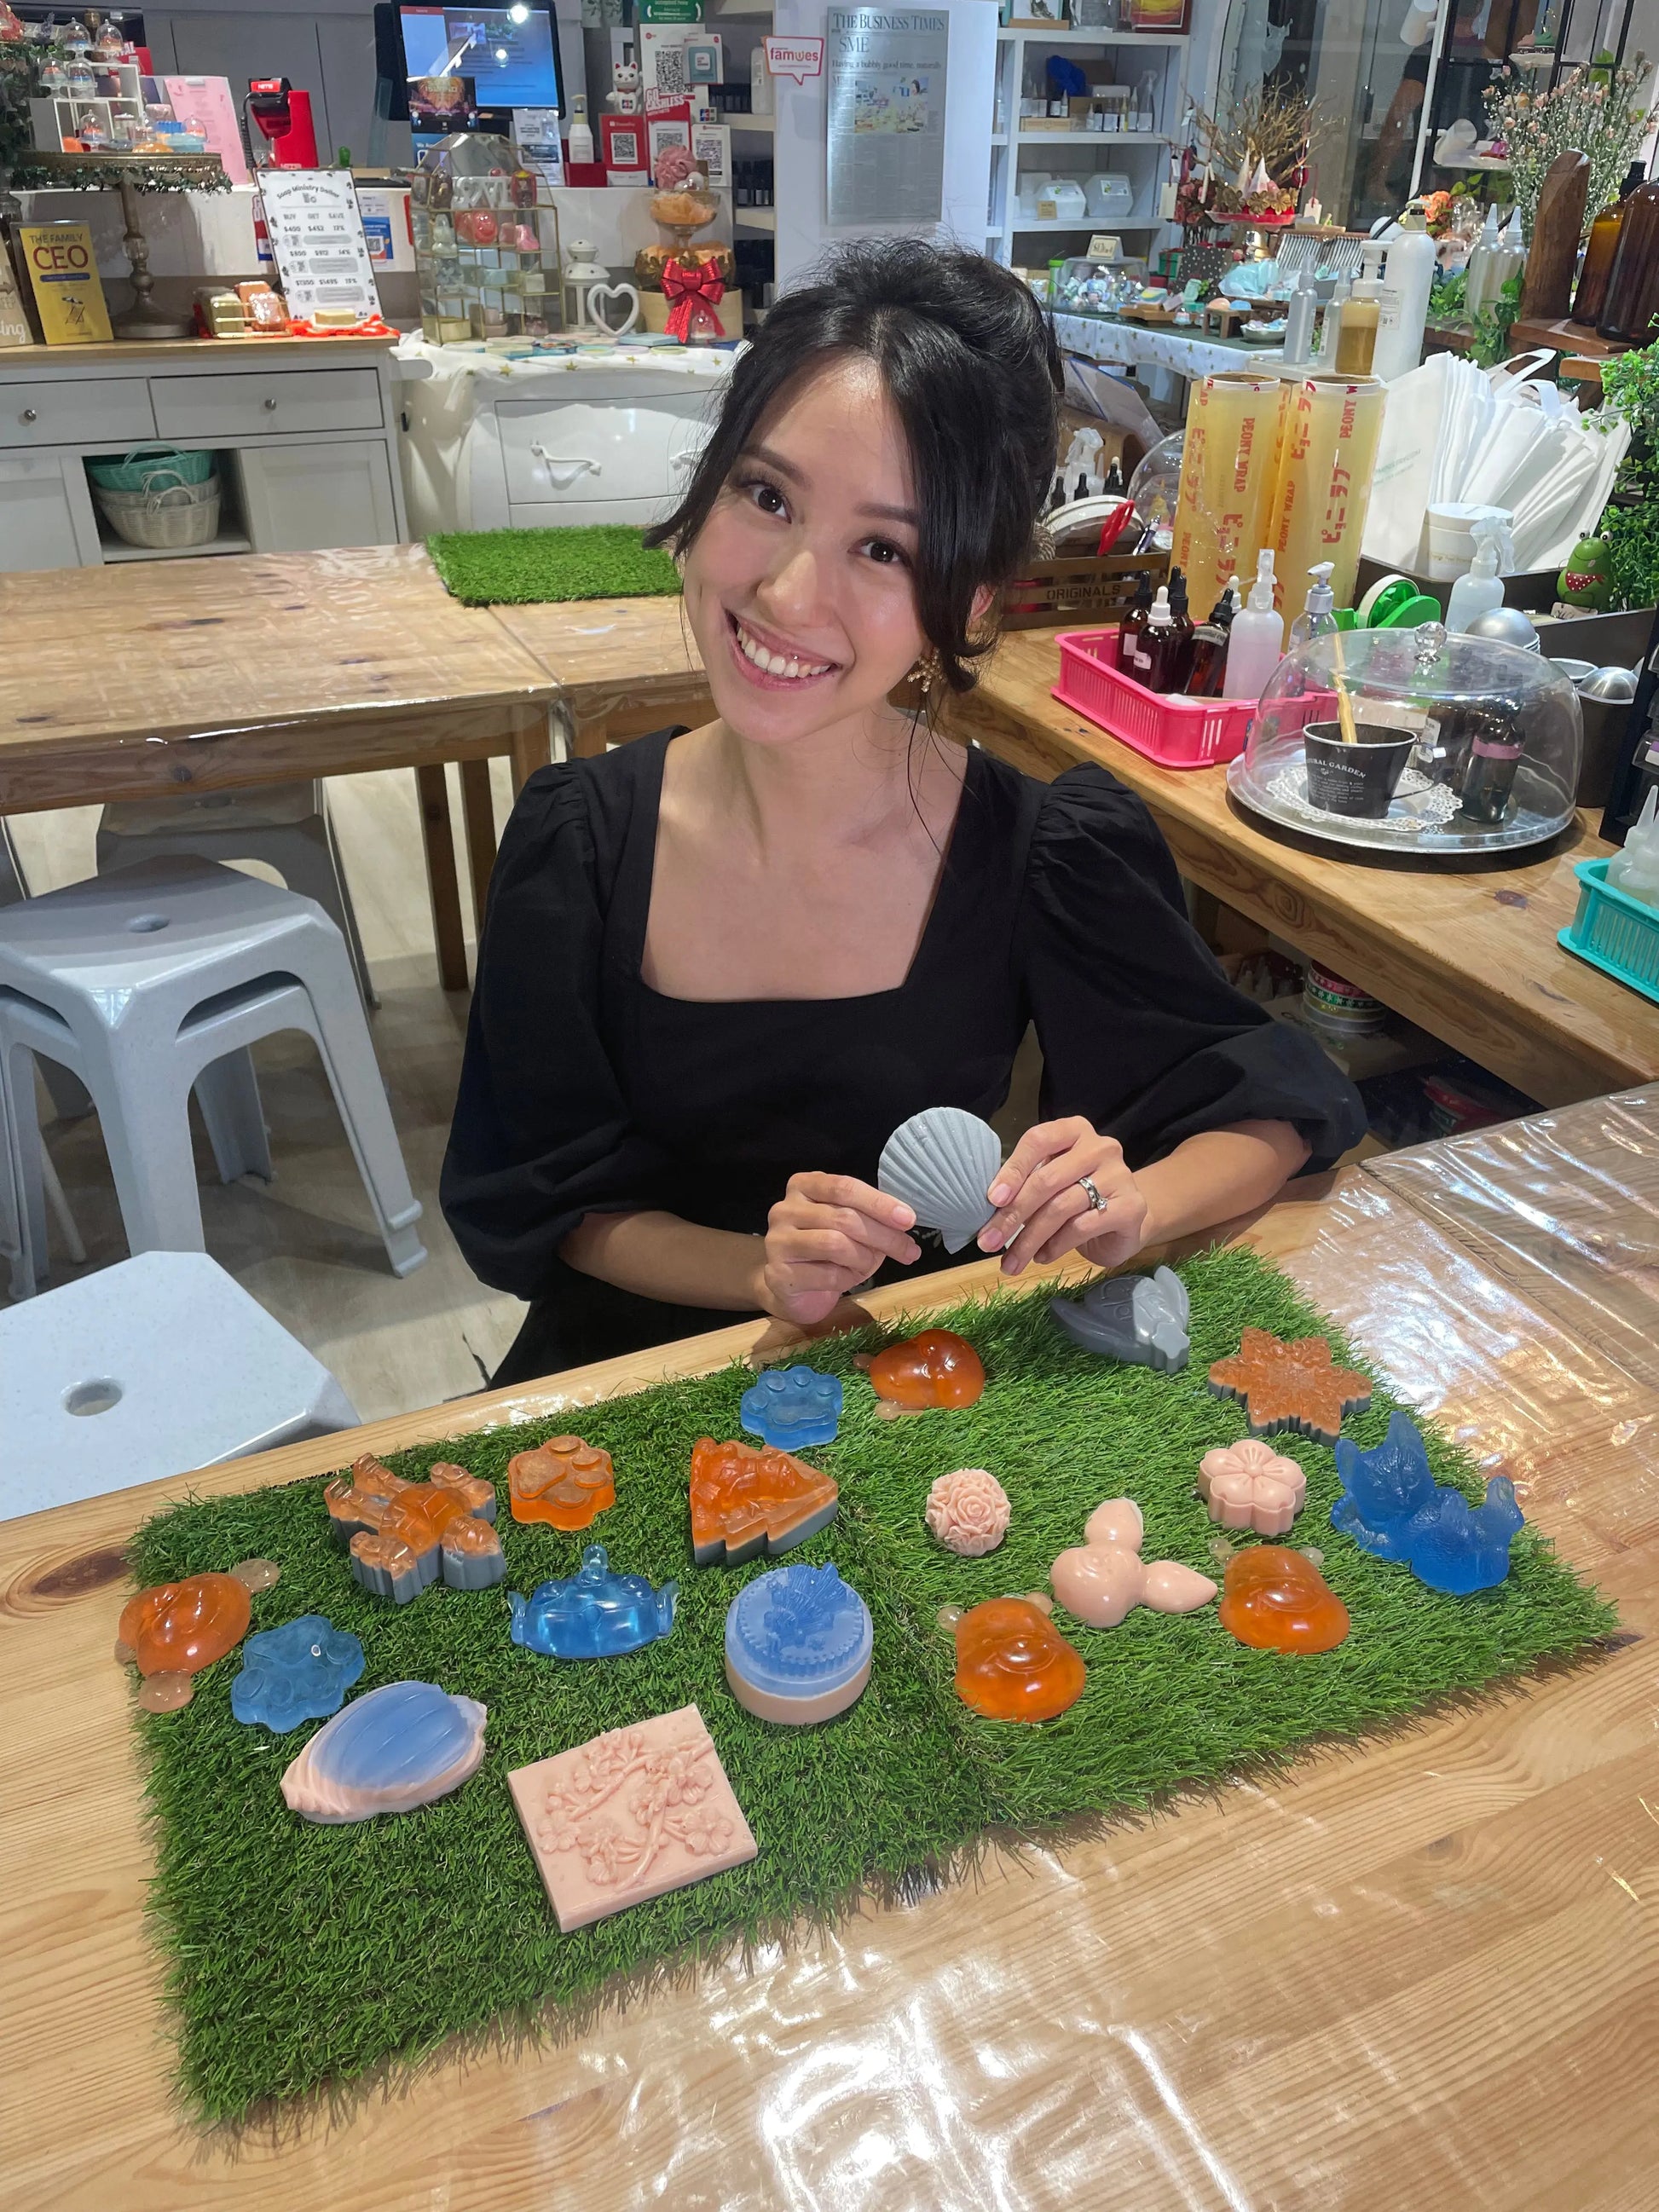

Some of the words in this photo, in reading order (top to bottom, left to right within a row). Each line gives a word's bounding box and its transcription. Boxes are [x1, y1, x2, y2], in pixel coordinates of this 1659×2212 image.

[833, 13, 858, 29] THE
[859, 14, 909, 30] BUSINESS
[911, 15, 945, 31] TIMES
[839, 36, 870, 53] SME
[832, 60, 853, 69] Having
[861, 60, 882, 70] bubbly
[882, 60, 899, 70] good
[292, 183, 319, 195] Ministry
[29, 234, 49, 244] THE
[49, 233, 84, 244] FAMILY
[32, 245, 89, 271] CEO
[1339, 399, 1357, 439] PEONY
[1240, 417, 1256, 456] PEONY
[1234, 457, 1249, 493] WRAP
[1284, 480, 1296, 512] WRAP
[1278, 517, 1291, 553] PEONY
[1046, 584, 1122, 601] ORIGINALS
[1329, 761, 1367, 779] GARDEN
